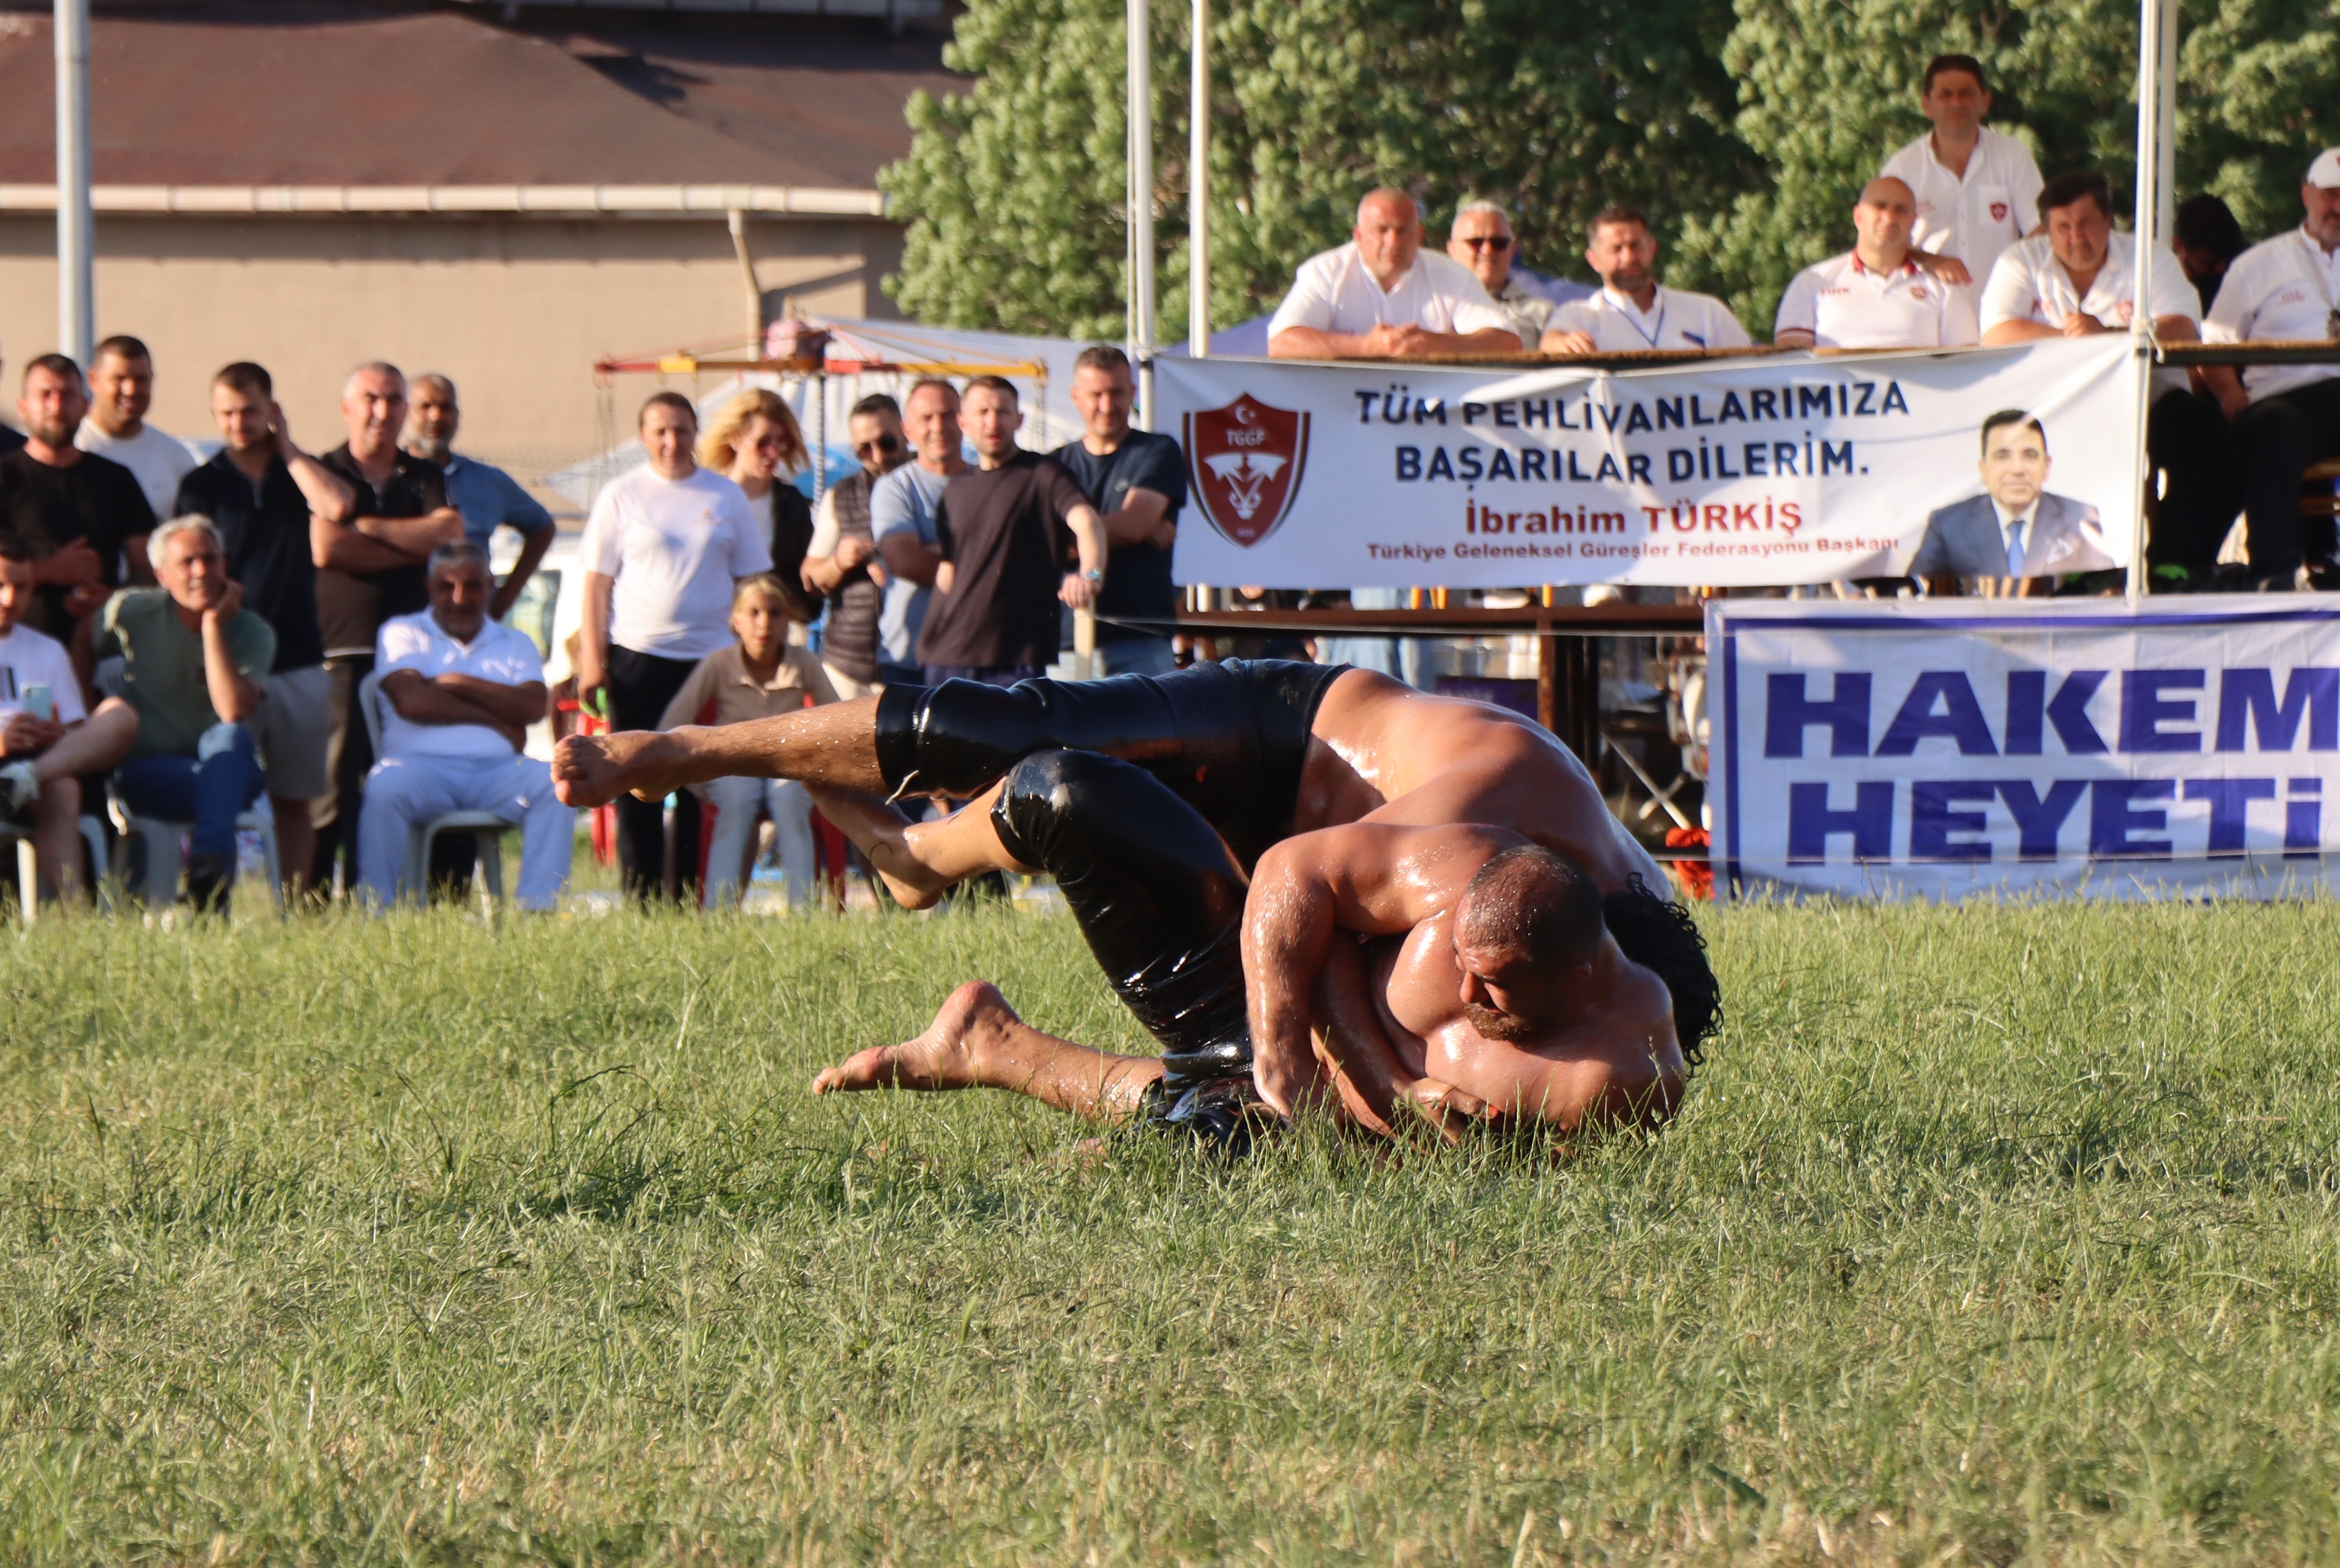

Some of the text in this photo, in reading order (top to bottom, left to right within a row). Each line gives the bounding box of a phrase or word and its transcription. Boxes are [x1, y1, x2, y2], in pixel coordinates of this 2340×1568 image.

[1355, 381, 1910, 436] TÜM PEHLİVANLARIMIZA
[1395, 430, 1869, 491] BAŞARILAR DİLERİM.
[1465, 495, 1802, 539] İbrahim TÜRKİŞ
[1367, 537, 1900, 563] Türkiye Geleneksel Güreşler Federasyonu Başkanı
[1764, 668, 2339, 758] HAKEM
